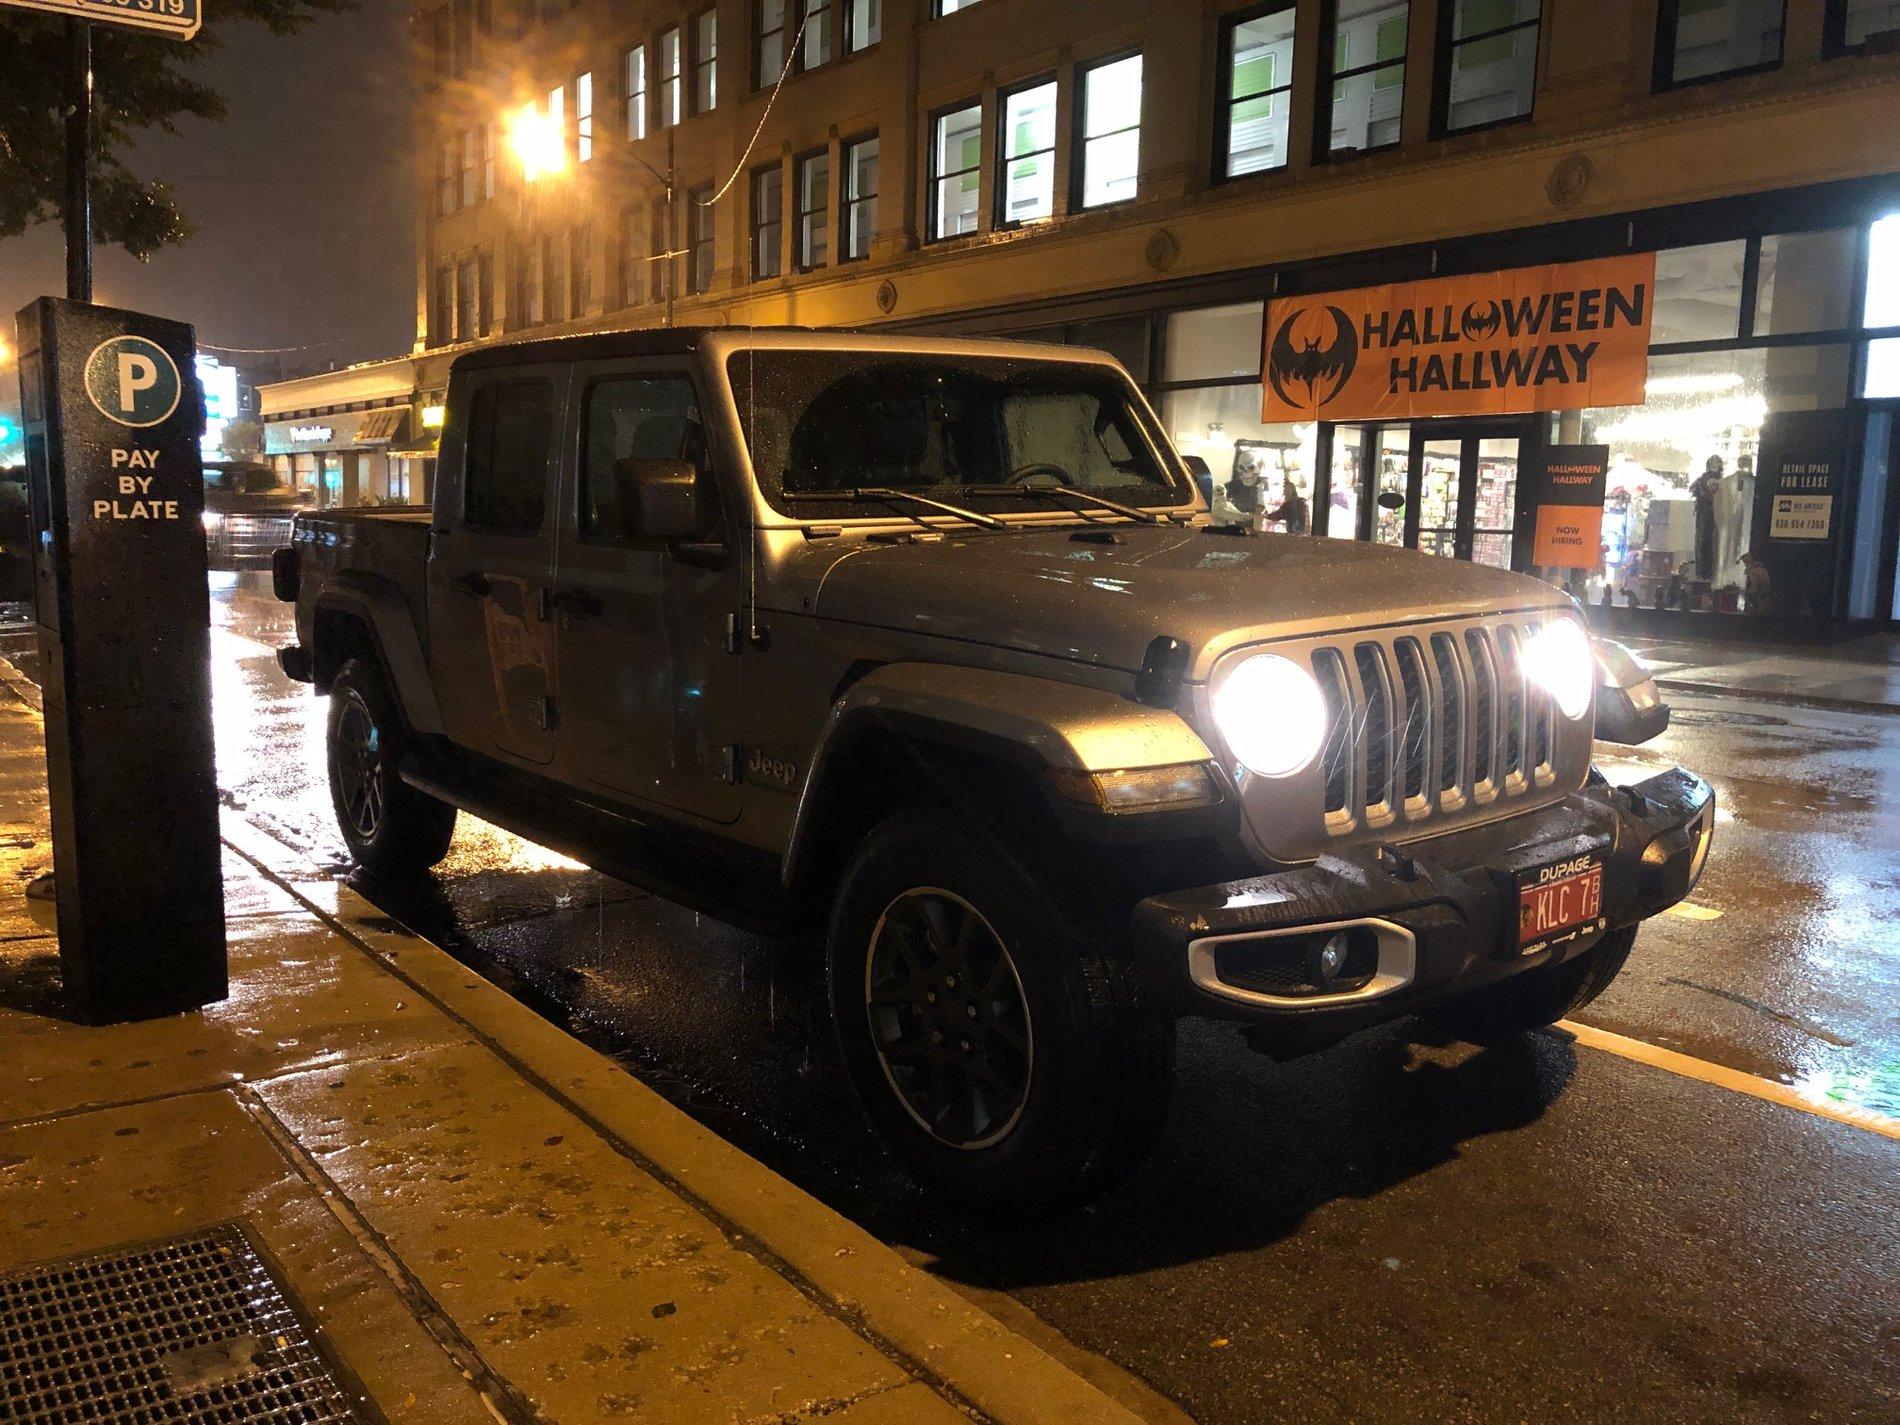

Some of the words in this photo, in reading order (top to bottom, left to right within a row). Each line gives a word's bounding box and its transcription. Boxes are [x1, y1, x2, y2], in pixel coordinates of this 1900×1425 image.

[1389, 341, 1600, 394] HALLWAY
[117, 352, 158, 412] P
[111, 449, 160, 468] PAY
[1782, 464, 1805, 474] RETAIL
[1808, 464, 1830, 474] SPACE
[119, 476, 153, 494] BY
[1552, 476, 1593, 484] HALLWAY
[1781, 476, 1798, 488] FOR
[1801, 476, 1829, 488] LEASE
[94, 500, 179, 519] PLATE
[1556, 526, 1580, 535] NOW
[1552, 537, 1583, 545] HIRING
[747, 749, 796, 786] Jeep
[1540, 855, 1590, 882] DUPAGE
[1536, 885, 1570, 931] KLC
